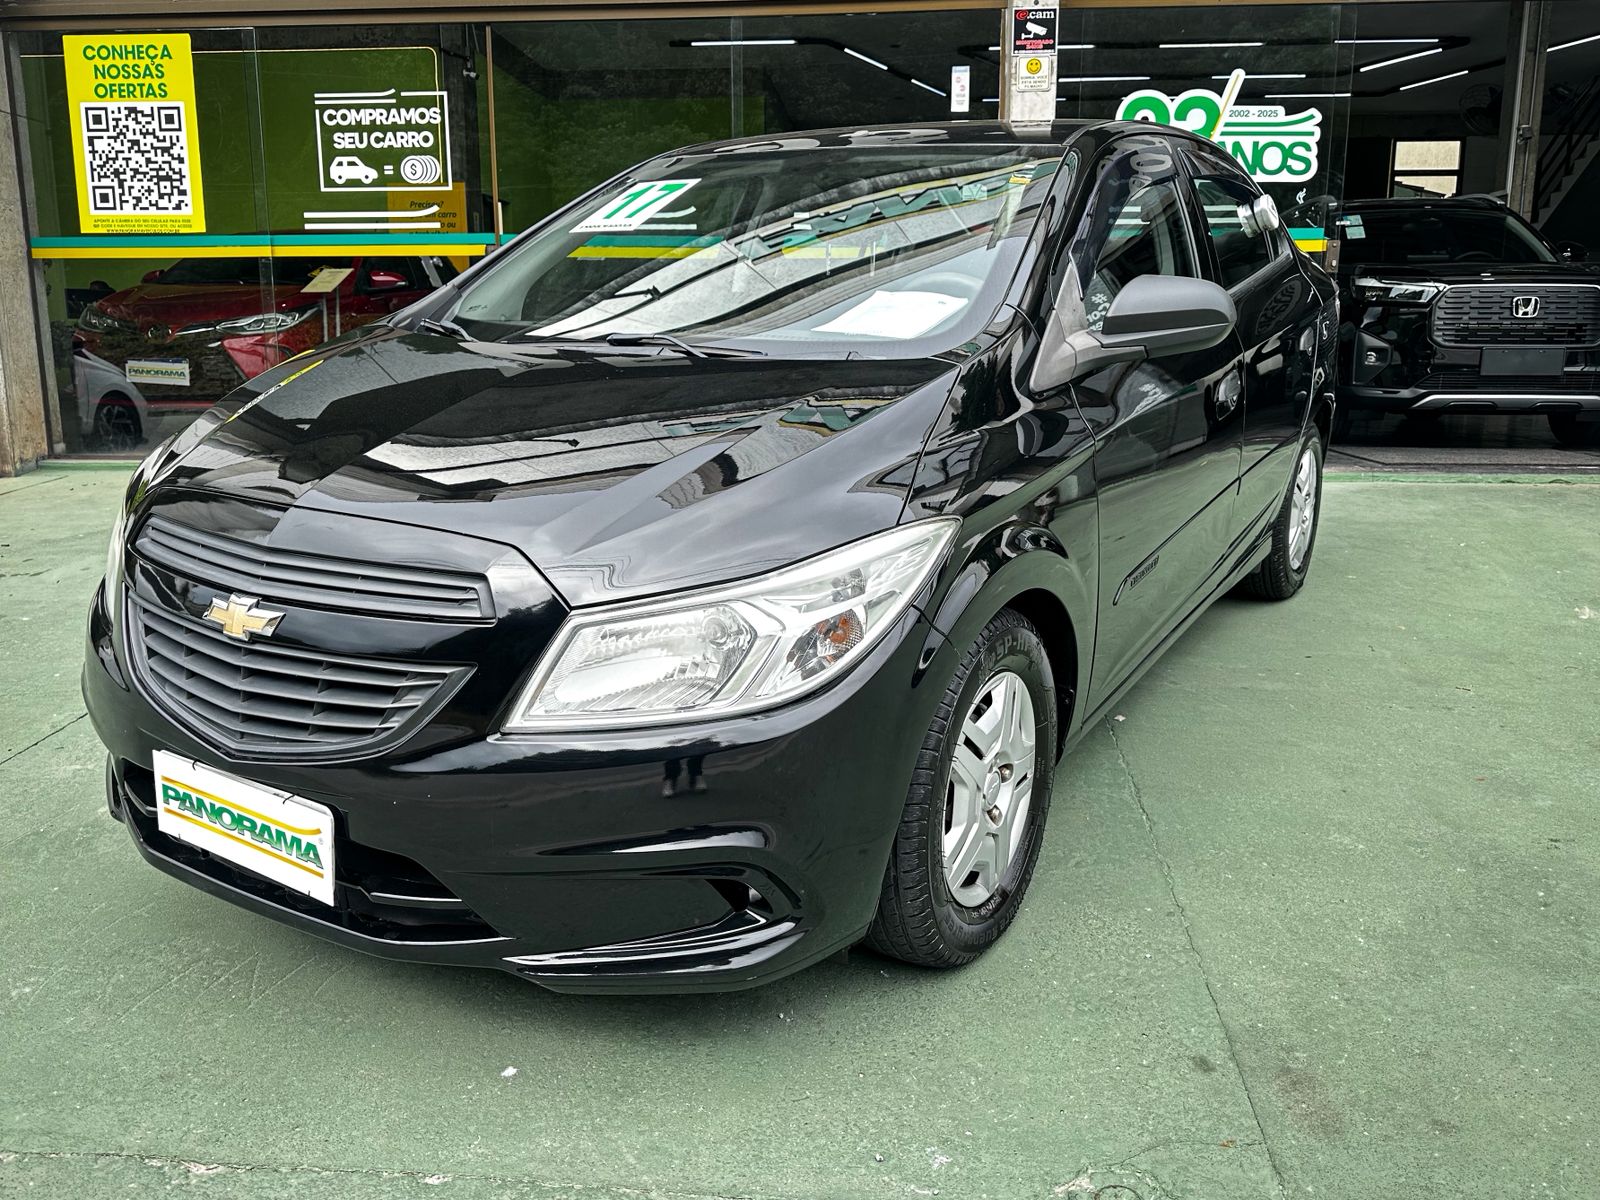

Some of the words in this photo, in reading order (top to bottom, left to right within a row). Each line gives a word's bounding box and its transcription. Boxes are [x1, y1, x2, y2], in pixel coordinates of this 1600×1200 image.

[82, 44, 173, 65] CONHEÇA
[93, 63, 165, 80] NOSSAS
[93, 82, 168, 99] OFERTAS
[323, 107, 442, 126] COMPRAMOS
[1228, 109, 1250, 118] 2002
[1257, 109, 1279, 118] 2025
[333, 132, 368, 149] SEU
[369, 131, 434, 149] CARRO
[128, 368, 187, 378] PANORAMA
[161, 783, 324, 870] PANORAMA
